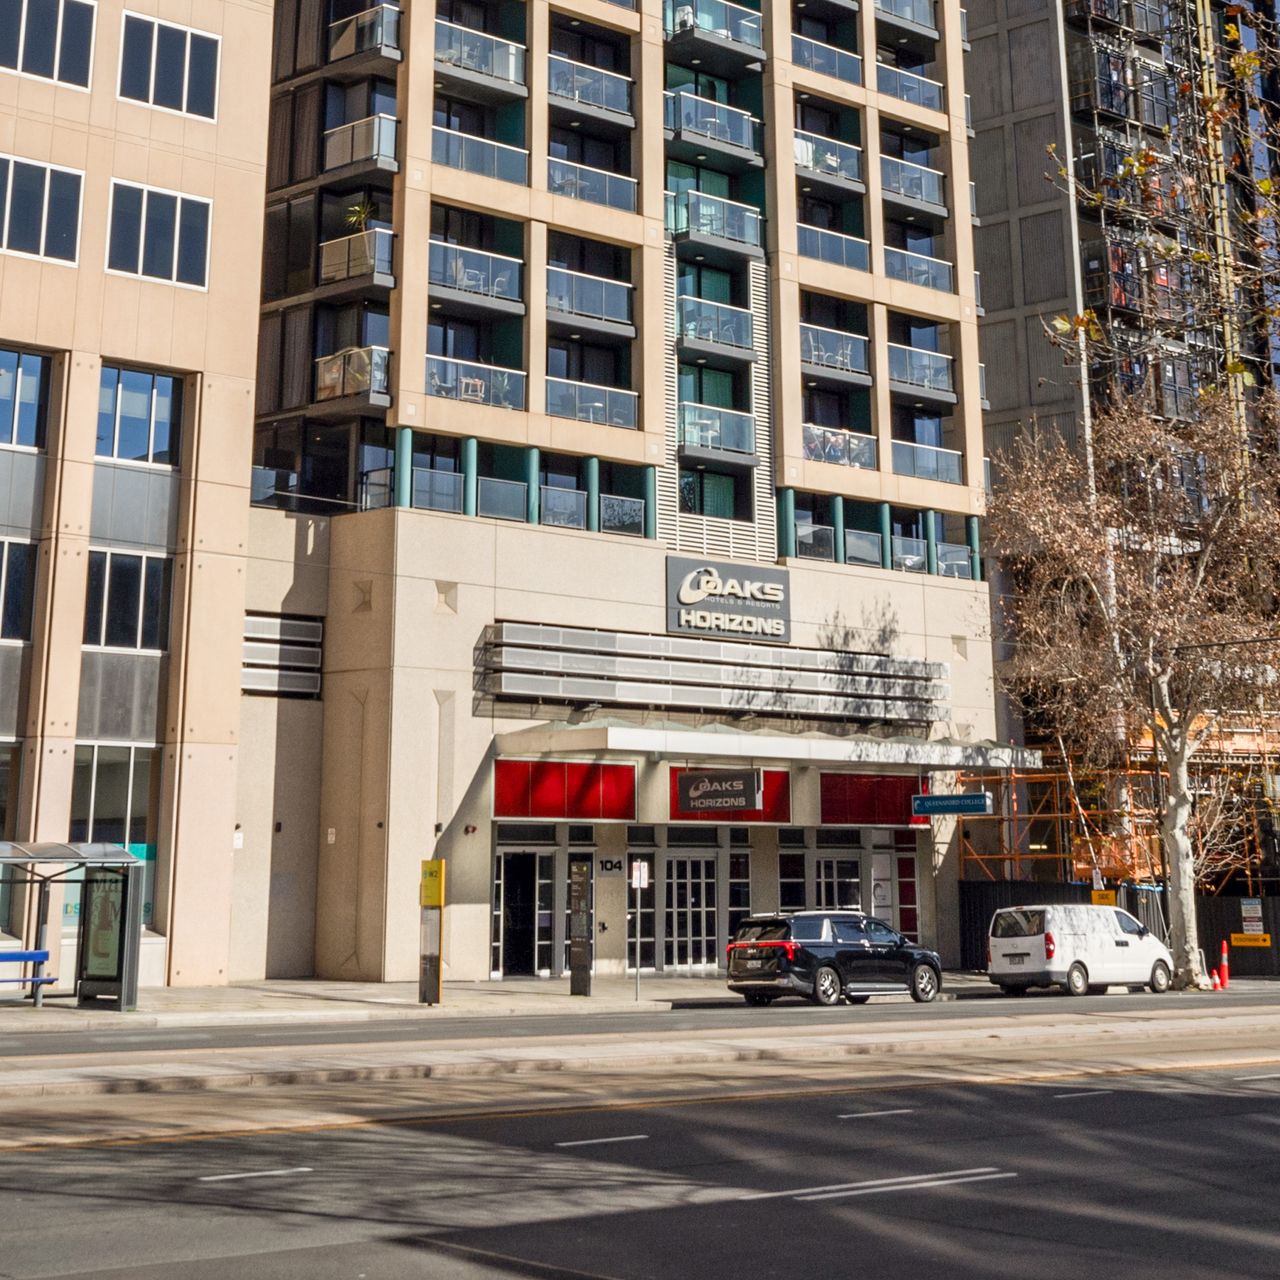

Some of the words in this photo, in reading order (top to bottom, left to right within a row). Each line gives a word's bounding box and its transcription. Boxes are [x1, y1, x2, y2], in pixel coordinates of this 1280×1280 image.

[697, 574, 785, 602] OAKS
[704, 596, 735, 605] HOTELS
[745, 600, 781, 610] RESORTS
[680, 608, 786, 636] HORIZONS
[699, 780, 744, 792] OAKS
[690, 797, 747, 808] HORIZONS
[599, 860, 623, 872] 104
